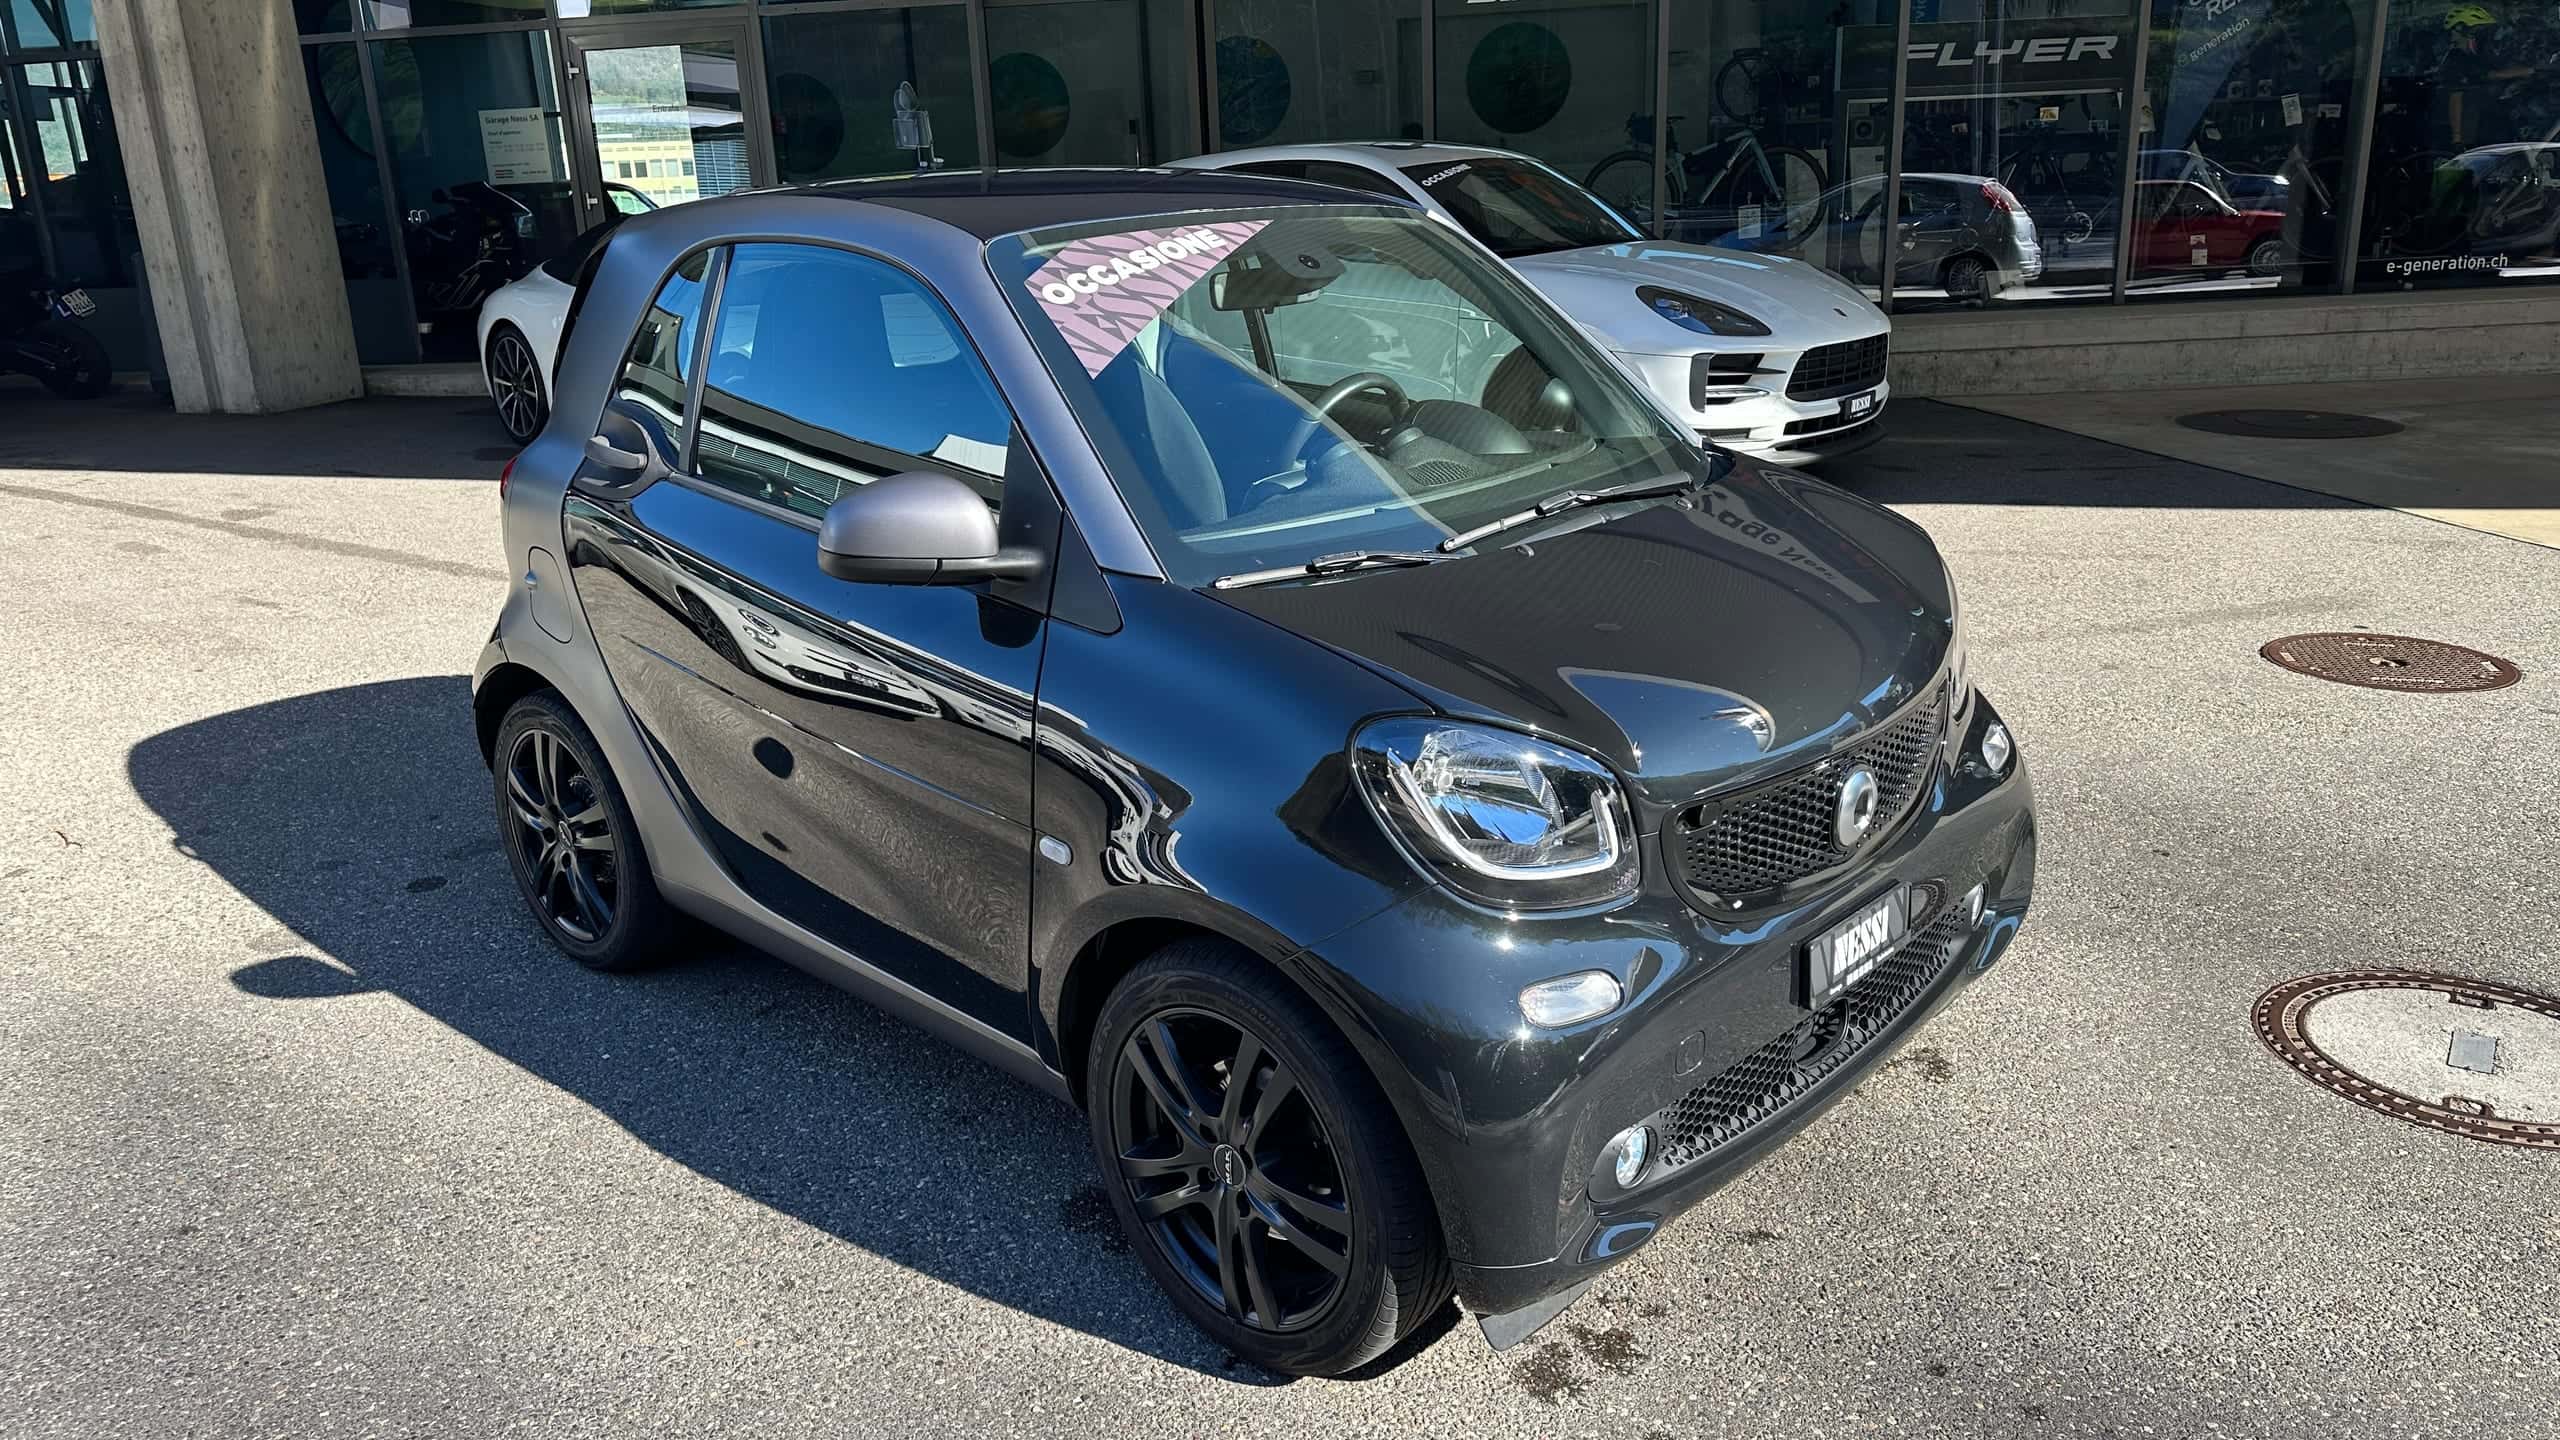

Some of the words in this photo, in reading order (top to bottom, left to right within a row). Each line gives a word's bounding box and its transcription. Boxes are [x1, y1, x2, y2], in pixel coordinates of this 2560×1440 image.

[1907, 35, 2119, 67] FLYER
[1421, 163, 1472, 187] OCCASIONE
[1041, 228, 1227, 305] OCCASIONE
[2386, 253, 2509, 276] e-generation.ch
[1833, 903, 1890, 977] NESSI
